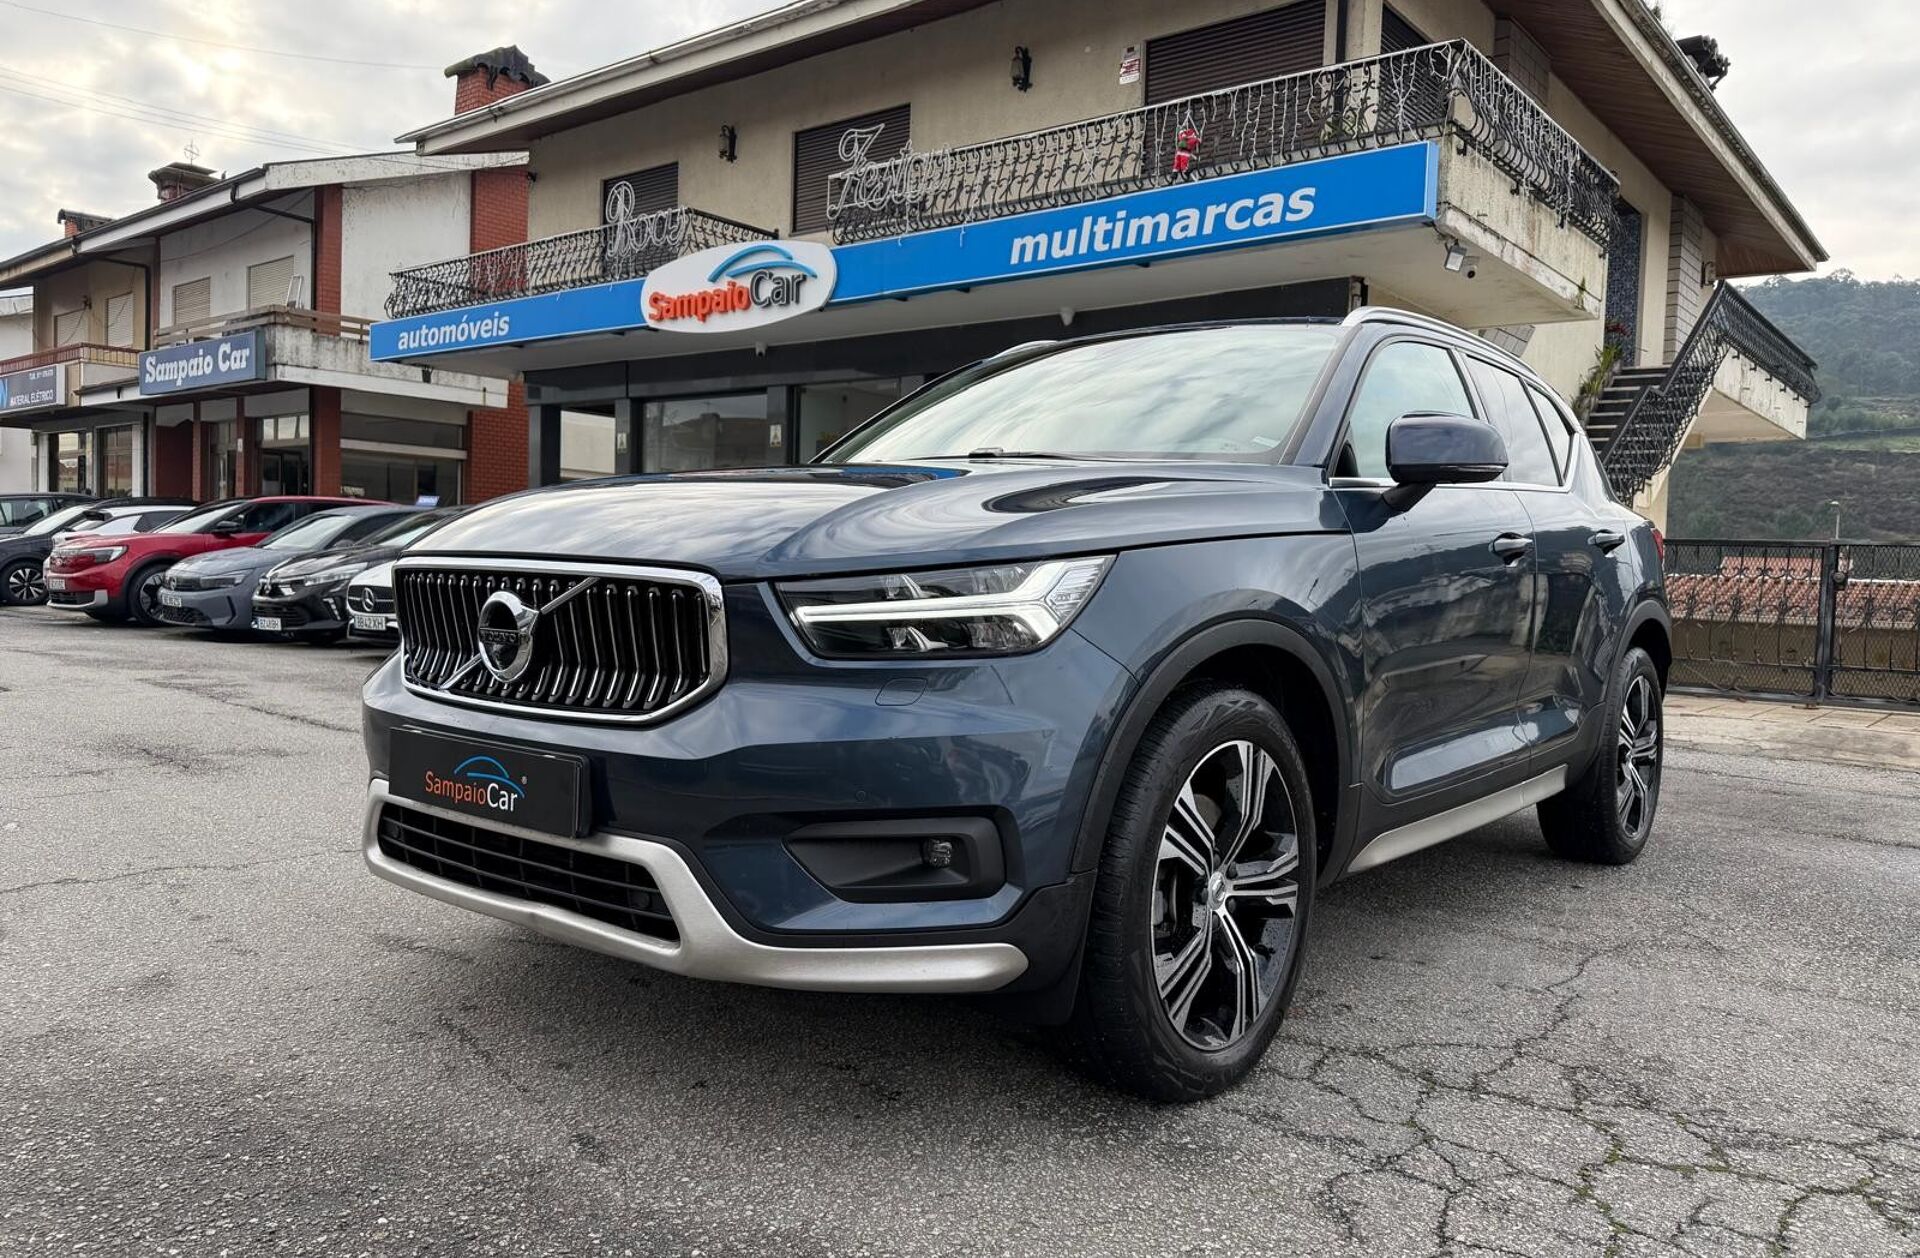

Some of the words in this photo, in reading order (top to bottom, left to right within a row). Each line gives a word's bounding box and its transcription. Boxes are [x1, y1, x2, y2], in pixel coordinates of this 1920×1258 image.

[1009, 187, 1316, 265] multimarcas
[649, 268, 808, 323] SampaioCar
[398, 311, 510, 350] automóveis
[145, 348, 214, 387] Sampaio
[218, 342, 250, 372] Car
[425, 770, 518, 812] SampaioCar
